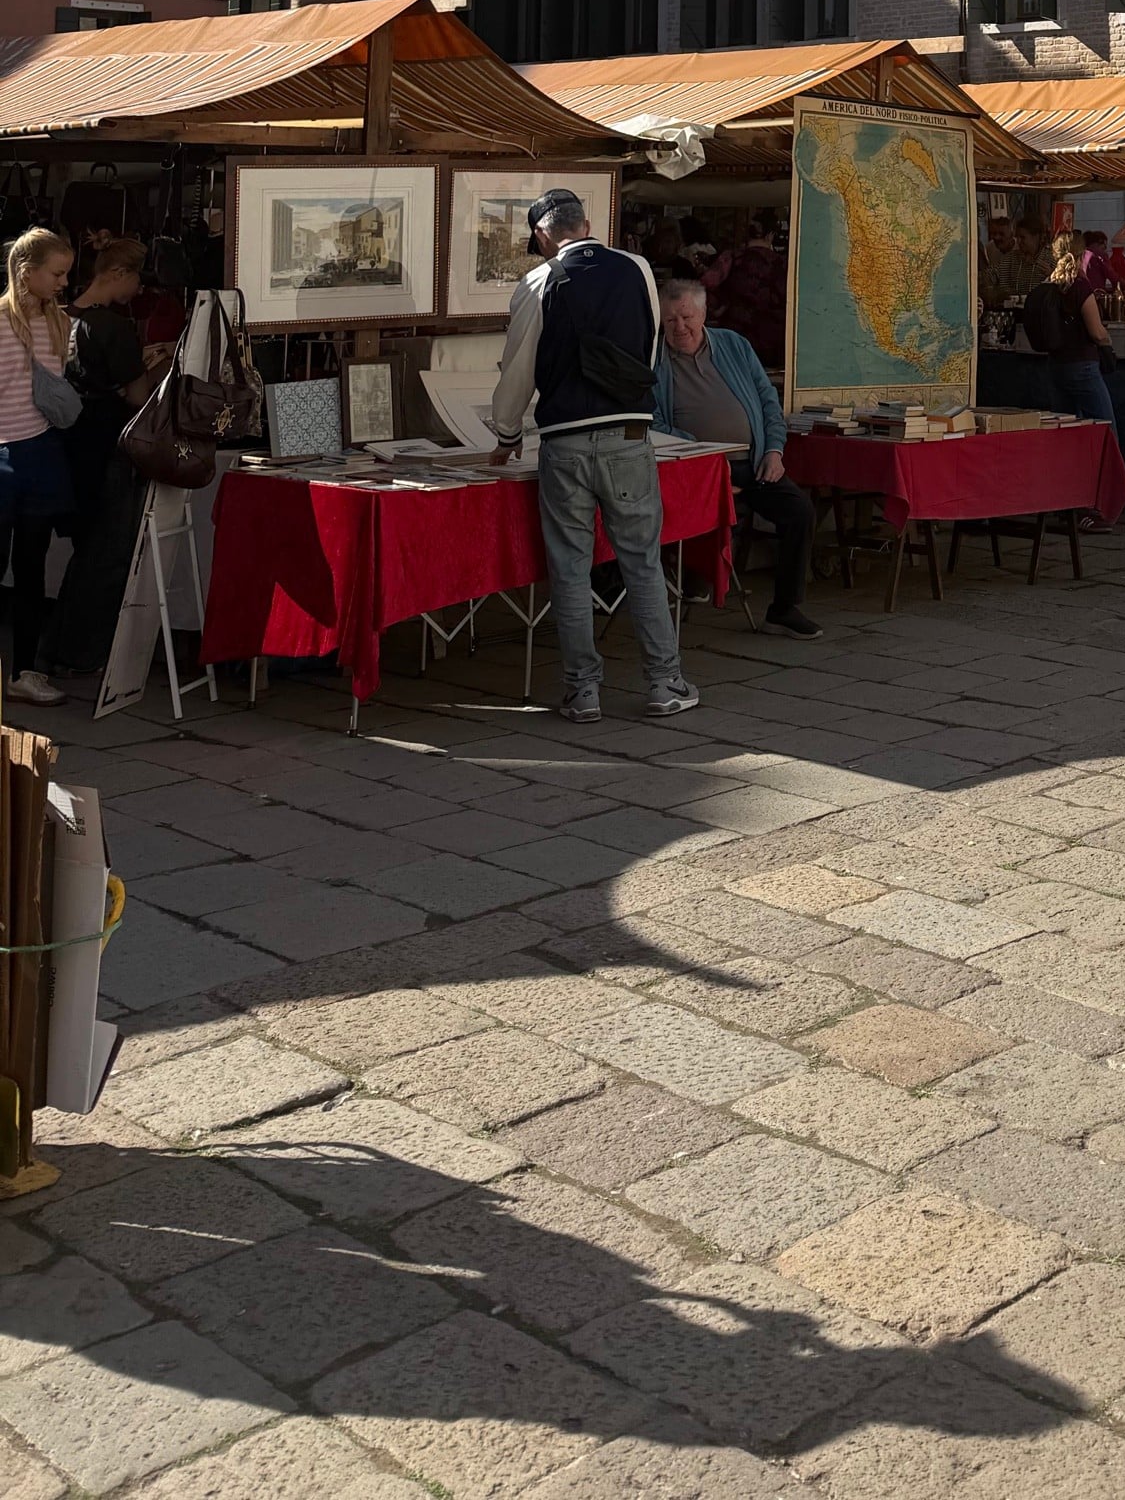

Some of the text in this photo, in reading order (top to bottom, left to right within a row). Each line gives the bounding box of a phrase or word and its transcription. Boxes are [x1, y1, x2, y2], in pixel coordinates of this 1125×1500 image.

[822, 100, 858, 115] AMERICA
[860, 105, 874, 117] DEL
[876, 107, 897, 119] NORD
